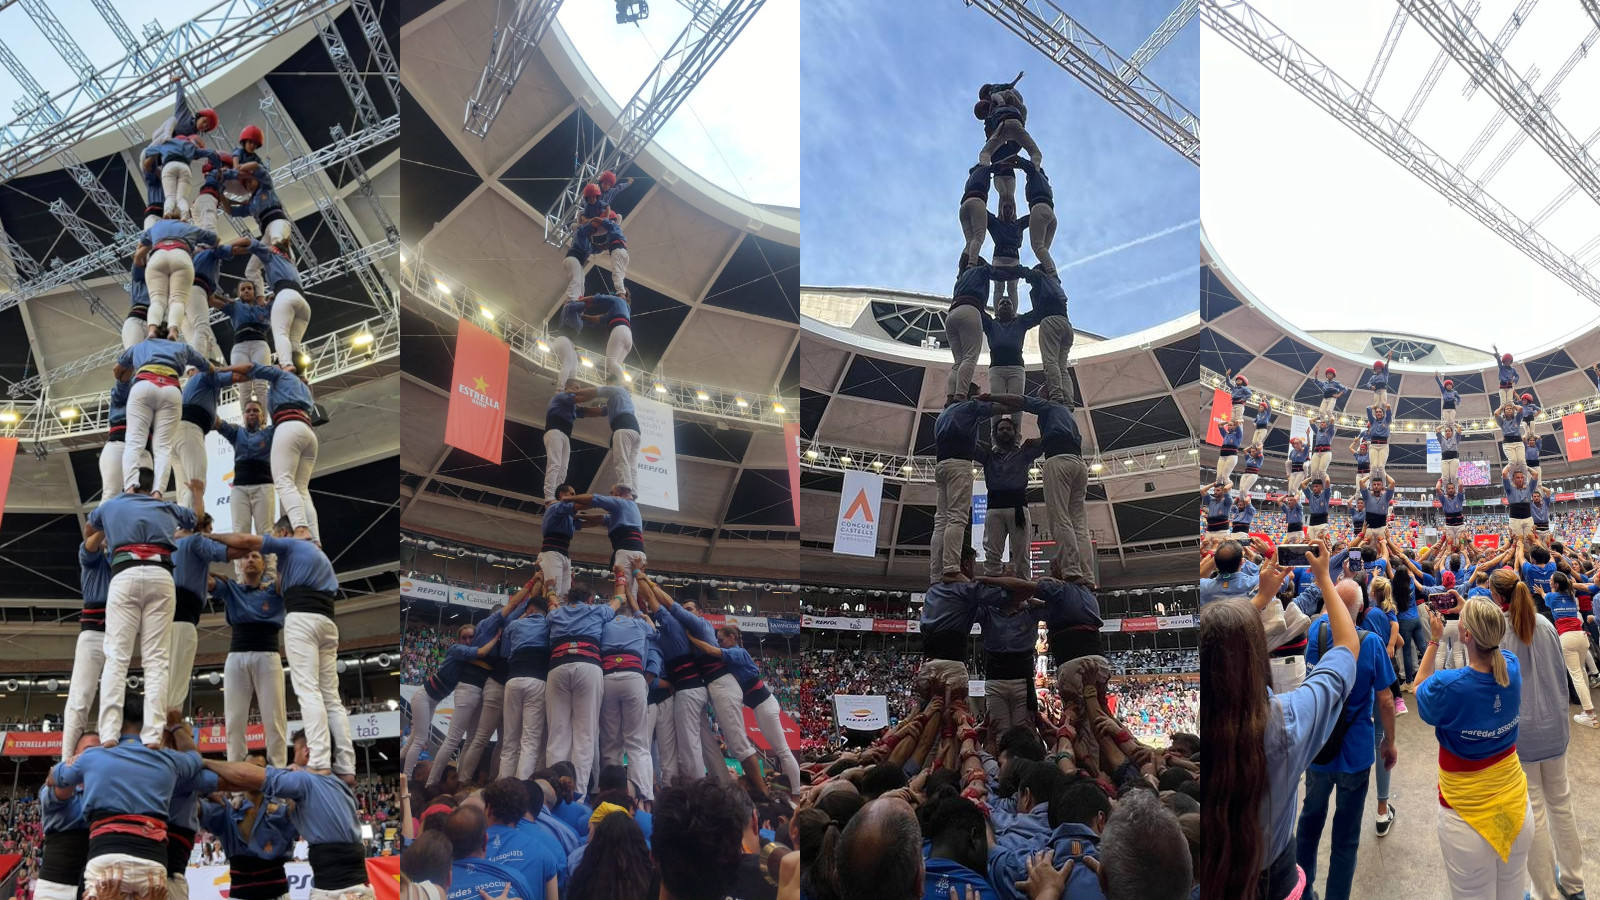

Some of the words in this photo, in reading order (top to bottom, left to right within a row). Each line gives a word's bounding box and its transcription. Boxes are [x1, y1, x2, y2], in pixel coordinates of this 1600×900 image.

[459, 383, 499, 410] ESTRELLA
[638, 463, 668, 475] REPSOL
[841, 522, 873, 530] CONCURS
[841, 527, 873, 536] CASTELLS
[417, 586, 447, 597] REPSOL
[466, 593, 503, 605] CaixaBank
[357, 728, 379, 738] tac
[15, 740, 46, 748] ESTRELLA
